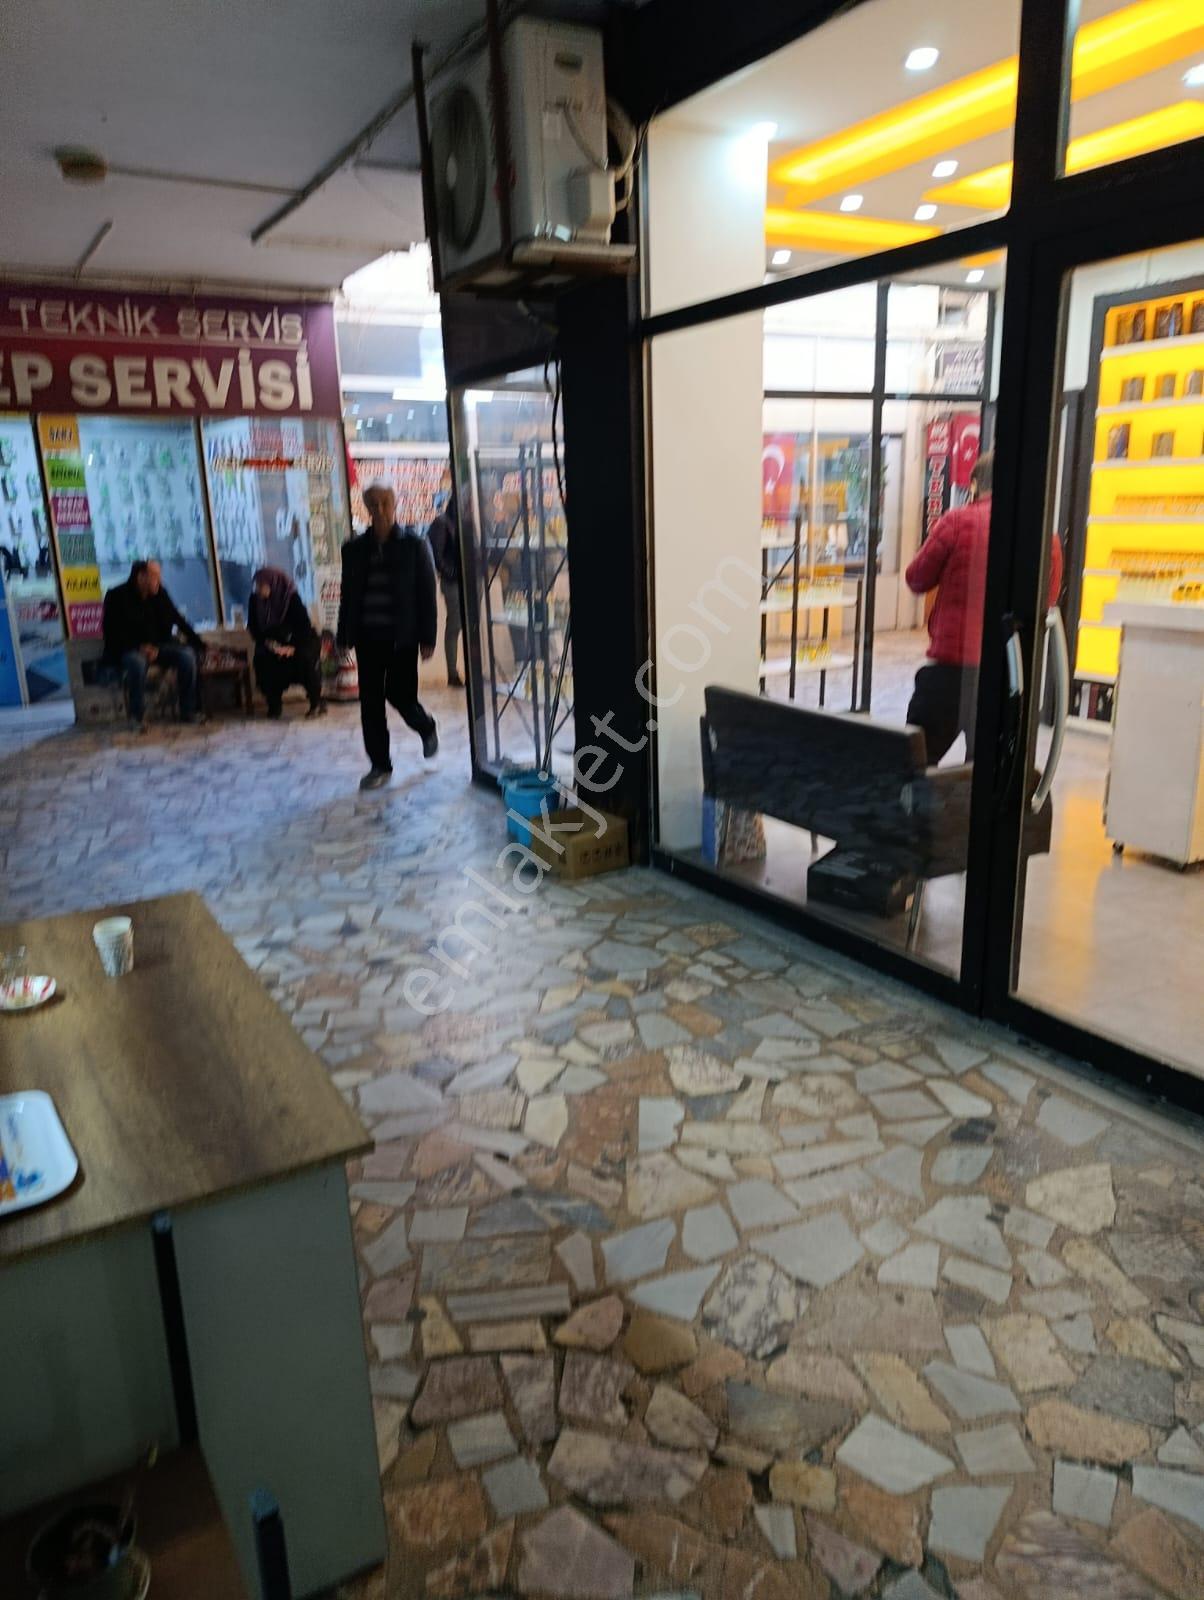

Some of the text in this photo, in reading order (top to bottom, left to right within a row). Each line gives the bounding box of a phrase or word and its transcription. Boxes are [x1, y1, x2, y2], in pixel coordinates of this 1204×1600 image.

[8, 297, 304, 345] TEKNİK SERVİS
[69, 342, 313, 410] SERVİSİ
